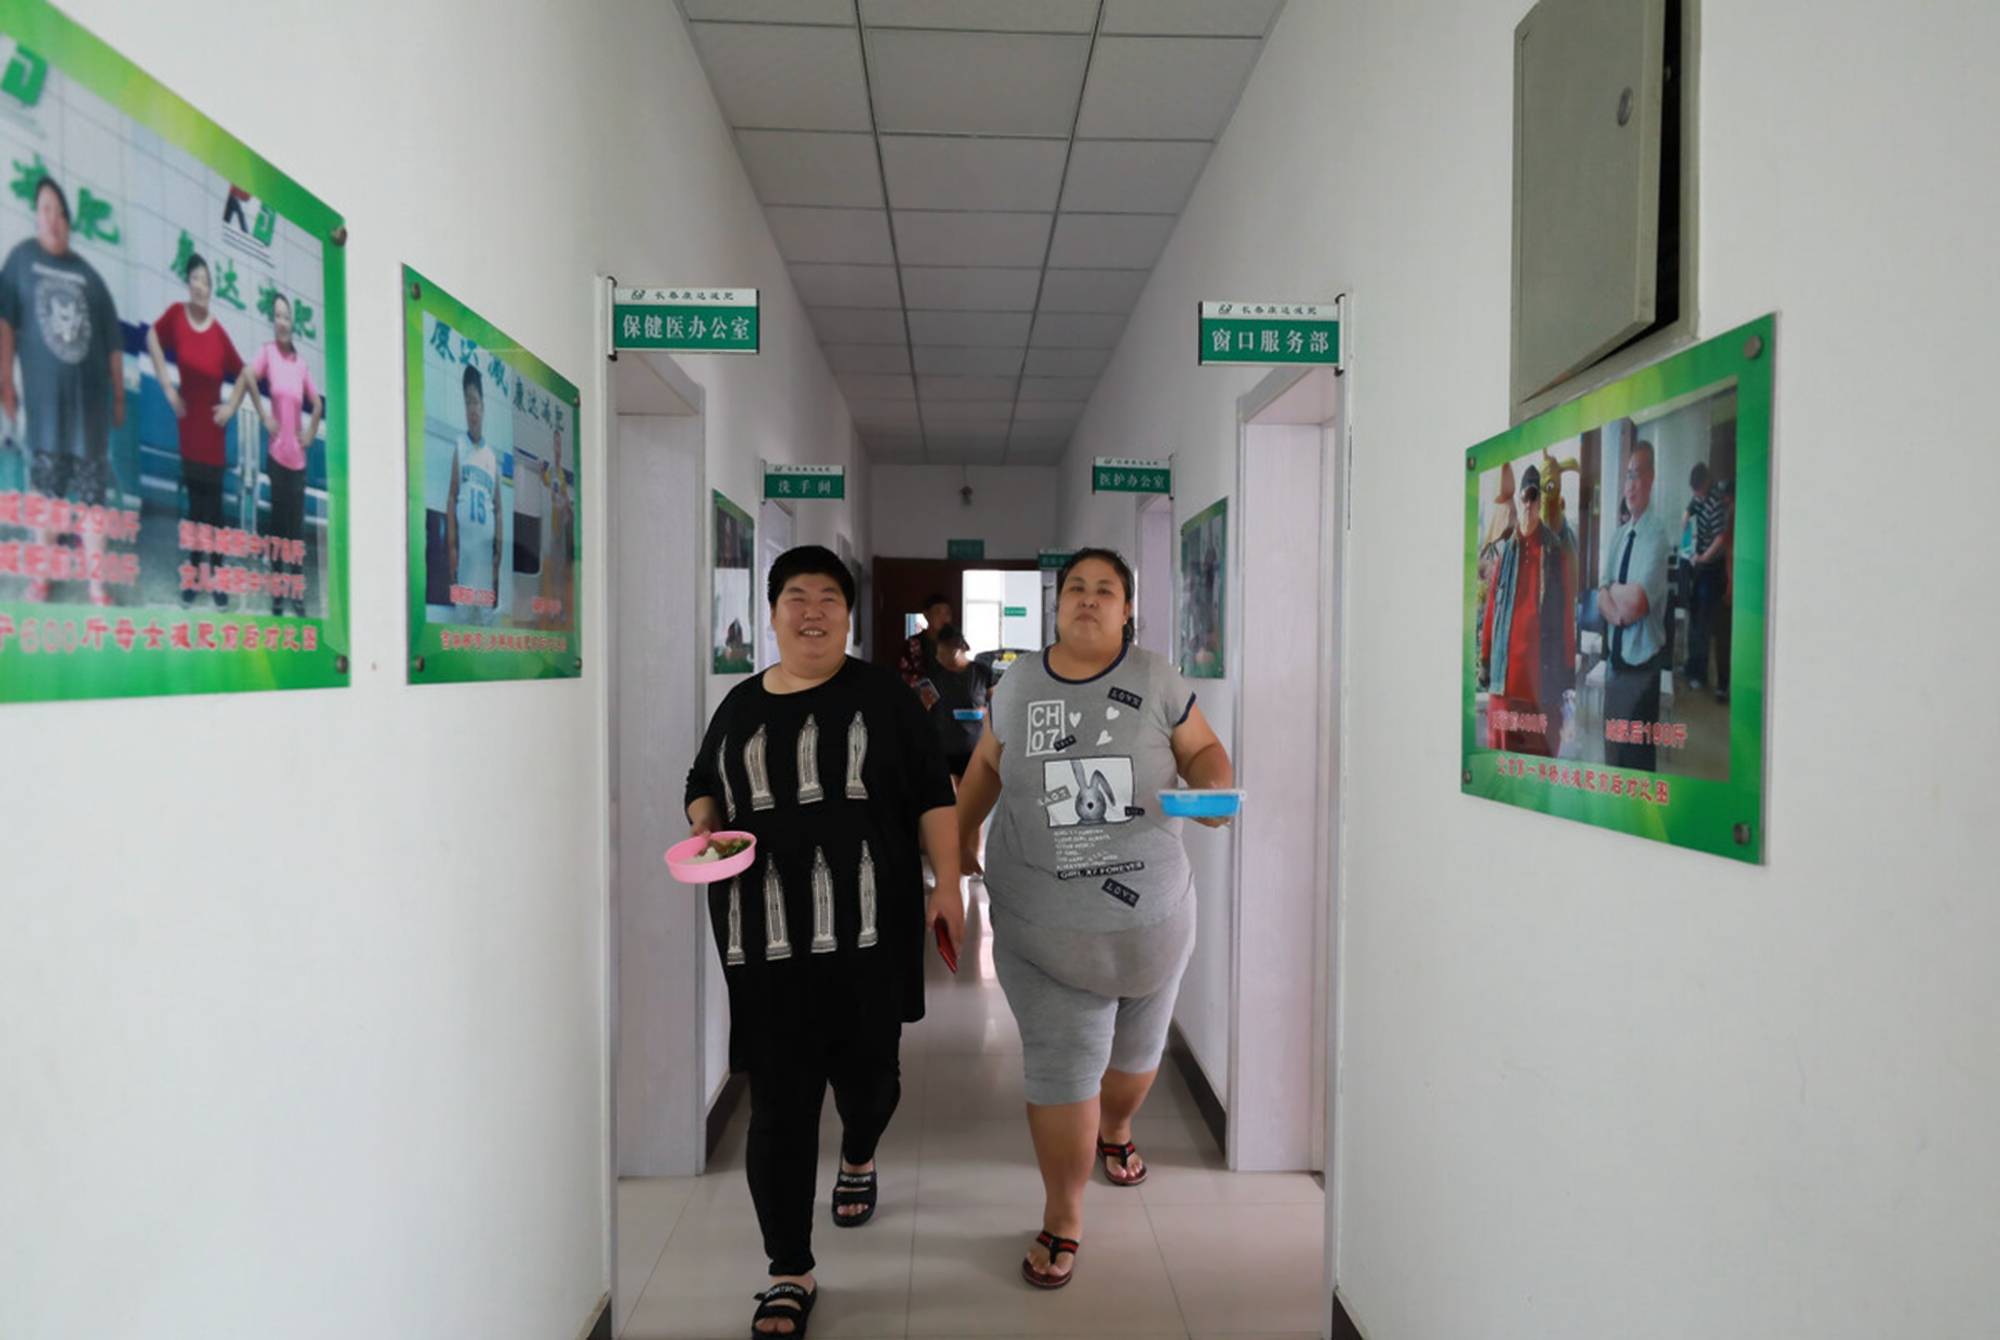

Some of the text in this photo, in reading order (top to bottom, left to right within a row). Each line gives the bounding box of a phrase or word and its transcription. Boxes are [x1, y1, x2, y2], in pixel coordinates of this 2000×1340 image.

[622, 313, 750, 340] 保健医办公室
[1212, 328, 1329, 354] 窗口服务部
[778, 480, 831, 495] 洗手间
[1099, 473, 1165, 489] 医护办公室
[1032, 705, 1059, 727] CH
[1031, 728, 1060, 752] 07
